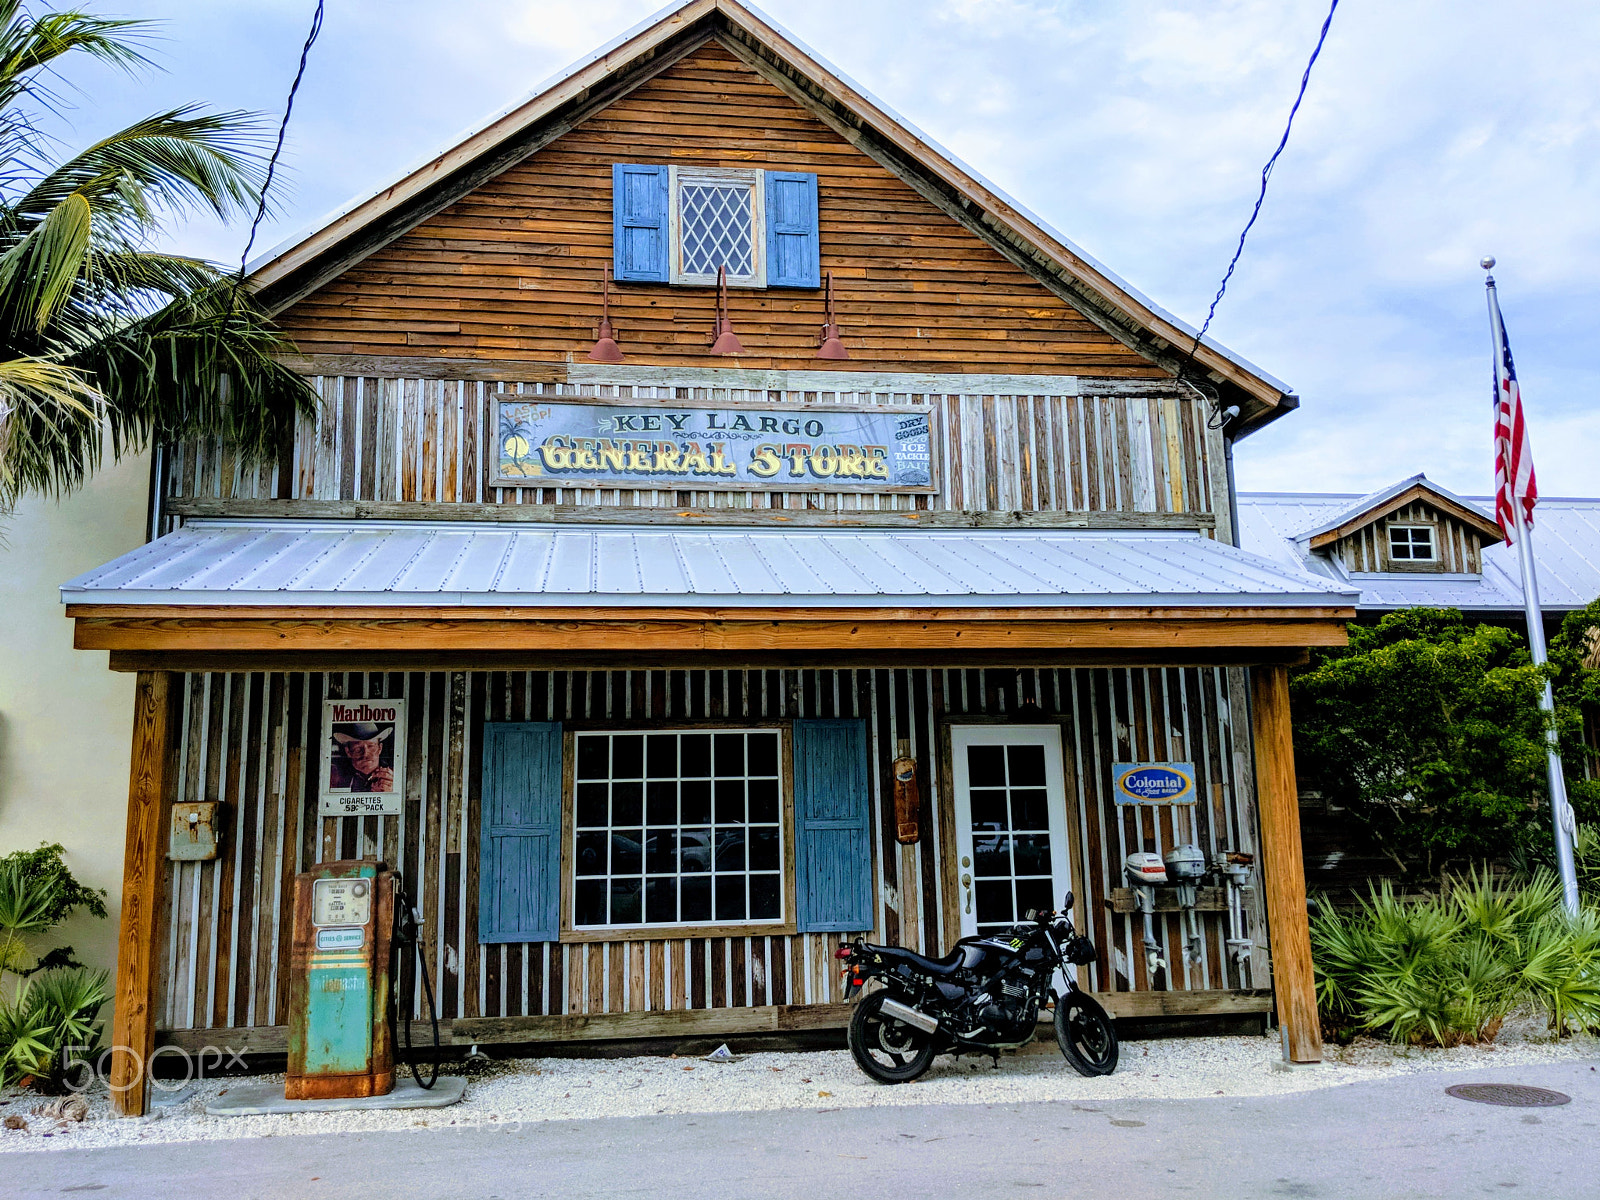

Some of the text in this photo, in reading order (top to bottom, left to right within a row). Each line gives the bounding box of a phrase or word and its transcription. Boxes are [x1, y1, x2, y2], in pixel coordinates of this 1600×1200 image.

[505, 403, 538, 419] LAST
[613, 413, 824, 437] KEY LARGO
[898, 417, 923, 430] DRY
[895, 425, 929, 441] GOODS
[900, 443, 926, 452] ICE
[536, 435, 889, 480] GENERAL STORE
[894, 452, 930, 461] TACKLE
[896, 461, 930, 473] BAIT
[332, 704, 396, 722] Marlboro
[1125, 775, 1182, 788] Colonial
[340, 797, 382, 805] CIGARETTES
[364, 803, 384, 812] PACK
